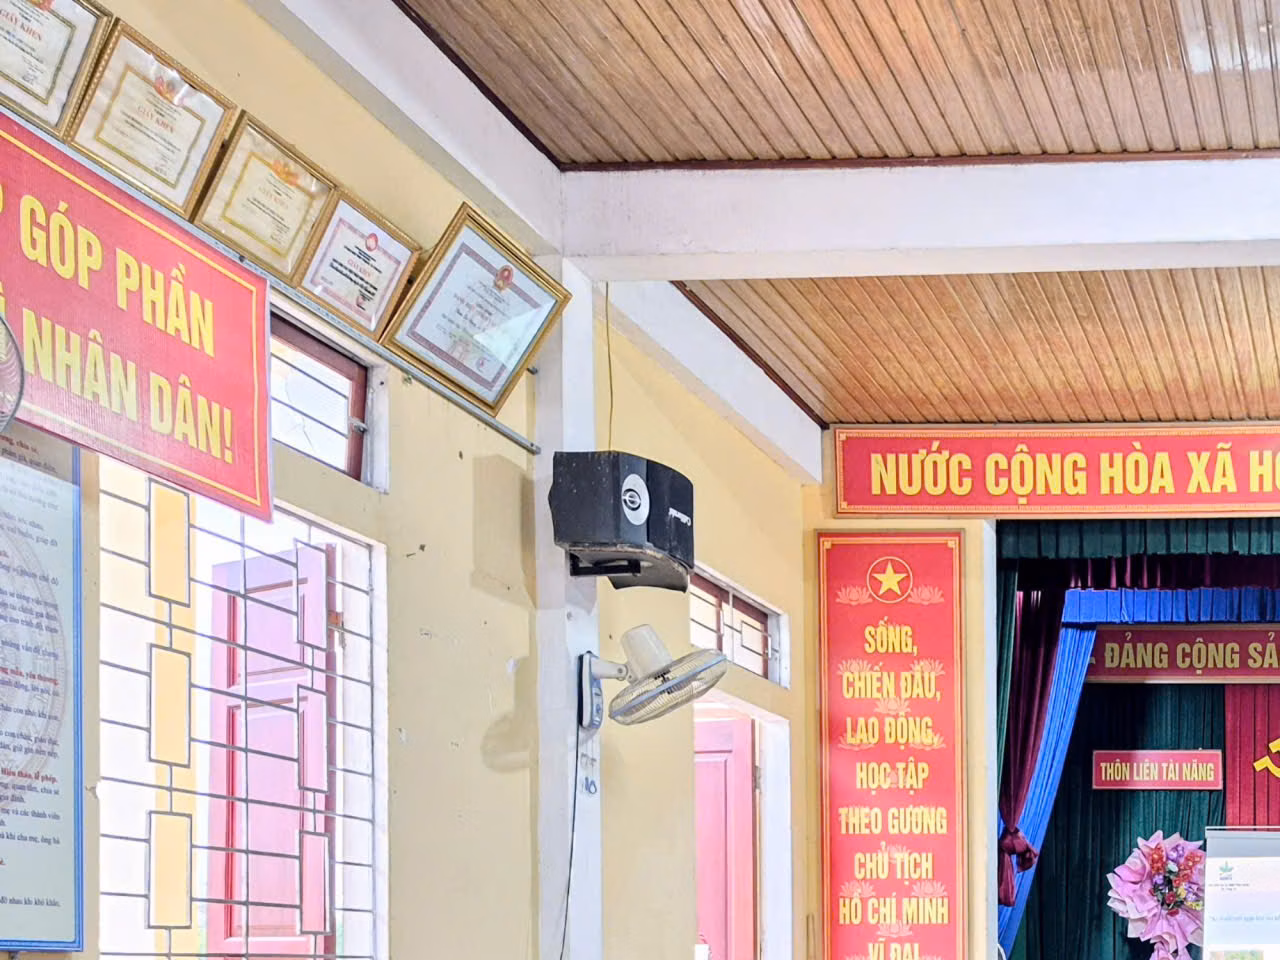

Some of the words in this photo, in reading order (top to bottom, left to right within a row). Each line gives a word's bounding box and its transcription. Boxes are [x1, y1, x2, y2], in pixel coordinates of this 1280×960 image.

[20, 194, 103, 291] GÓP
[116, 247, 215, 358] PHẦN
[22, 307, 138, 422] NHÂN
[150, 371, 234, 465] DÂN!
[870, 442, 972, 496] NƯỚC
[985, 444, 1087, 504] CỘNG
[1100, 442, 1175, 495] HÒA
[1186, 442, 1237, 494] XÃ
[864, 616, 918, 657] SỐNG,
[1104, 632, 1169, 669] ĐẢNG
[1176, 637, 1240, 675] CỘNG
[842, 662, 896, 699] CHIẾN
[900, 662, 941, 702] ĐẤU,
[846, 716, 879, 745] LAO
[884, 712, 939, 750] ĐỘNG,
[856, 762, 891, 795] HỌC
[896, 756, 929, 795] TẬP
[1100, 758, 1130, 781] THÔN
[1133, 758, 1158, 781] LIÊN
[1161, 759, 1179, 781] TÀI
[1182, 758, 1215, 781] NĂNG
[839, 807, 882, 835] THEO
[887, 805, 947, 835] GƯƠNG
[854, 841, 889, 880] CHỦ
[896, 853, 933, 886] TỊCH
[839, 887, 862, 925] HỒ
[867, 892, 897, 925] CHÍ
[902, 898, 949, 925] MINH
